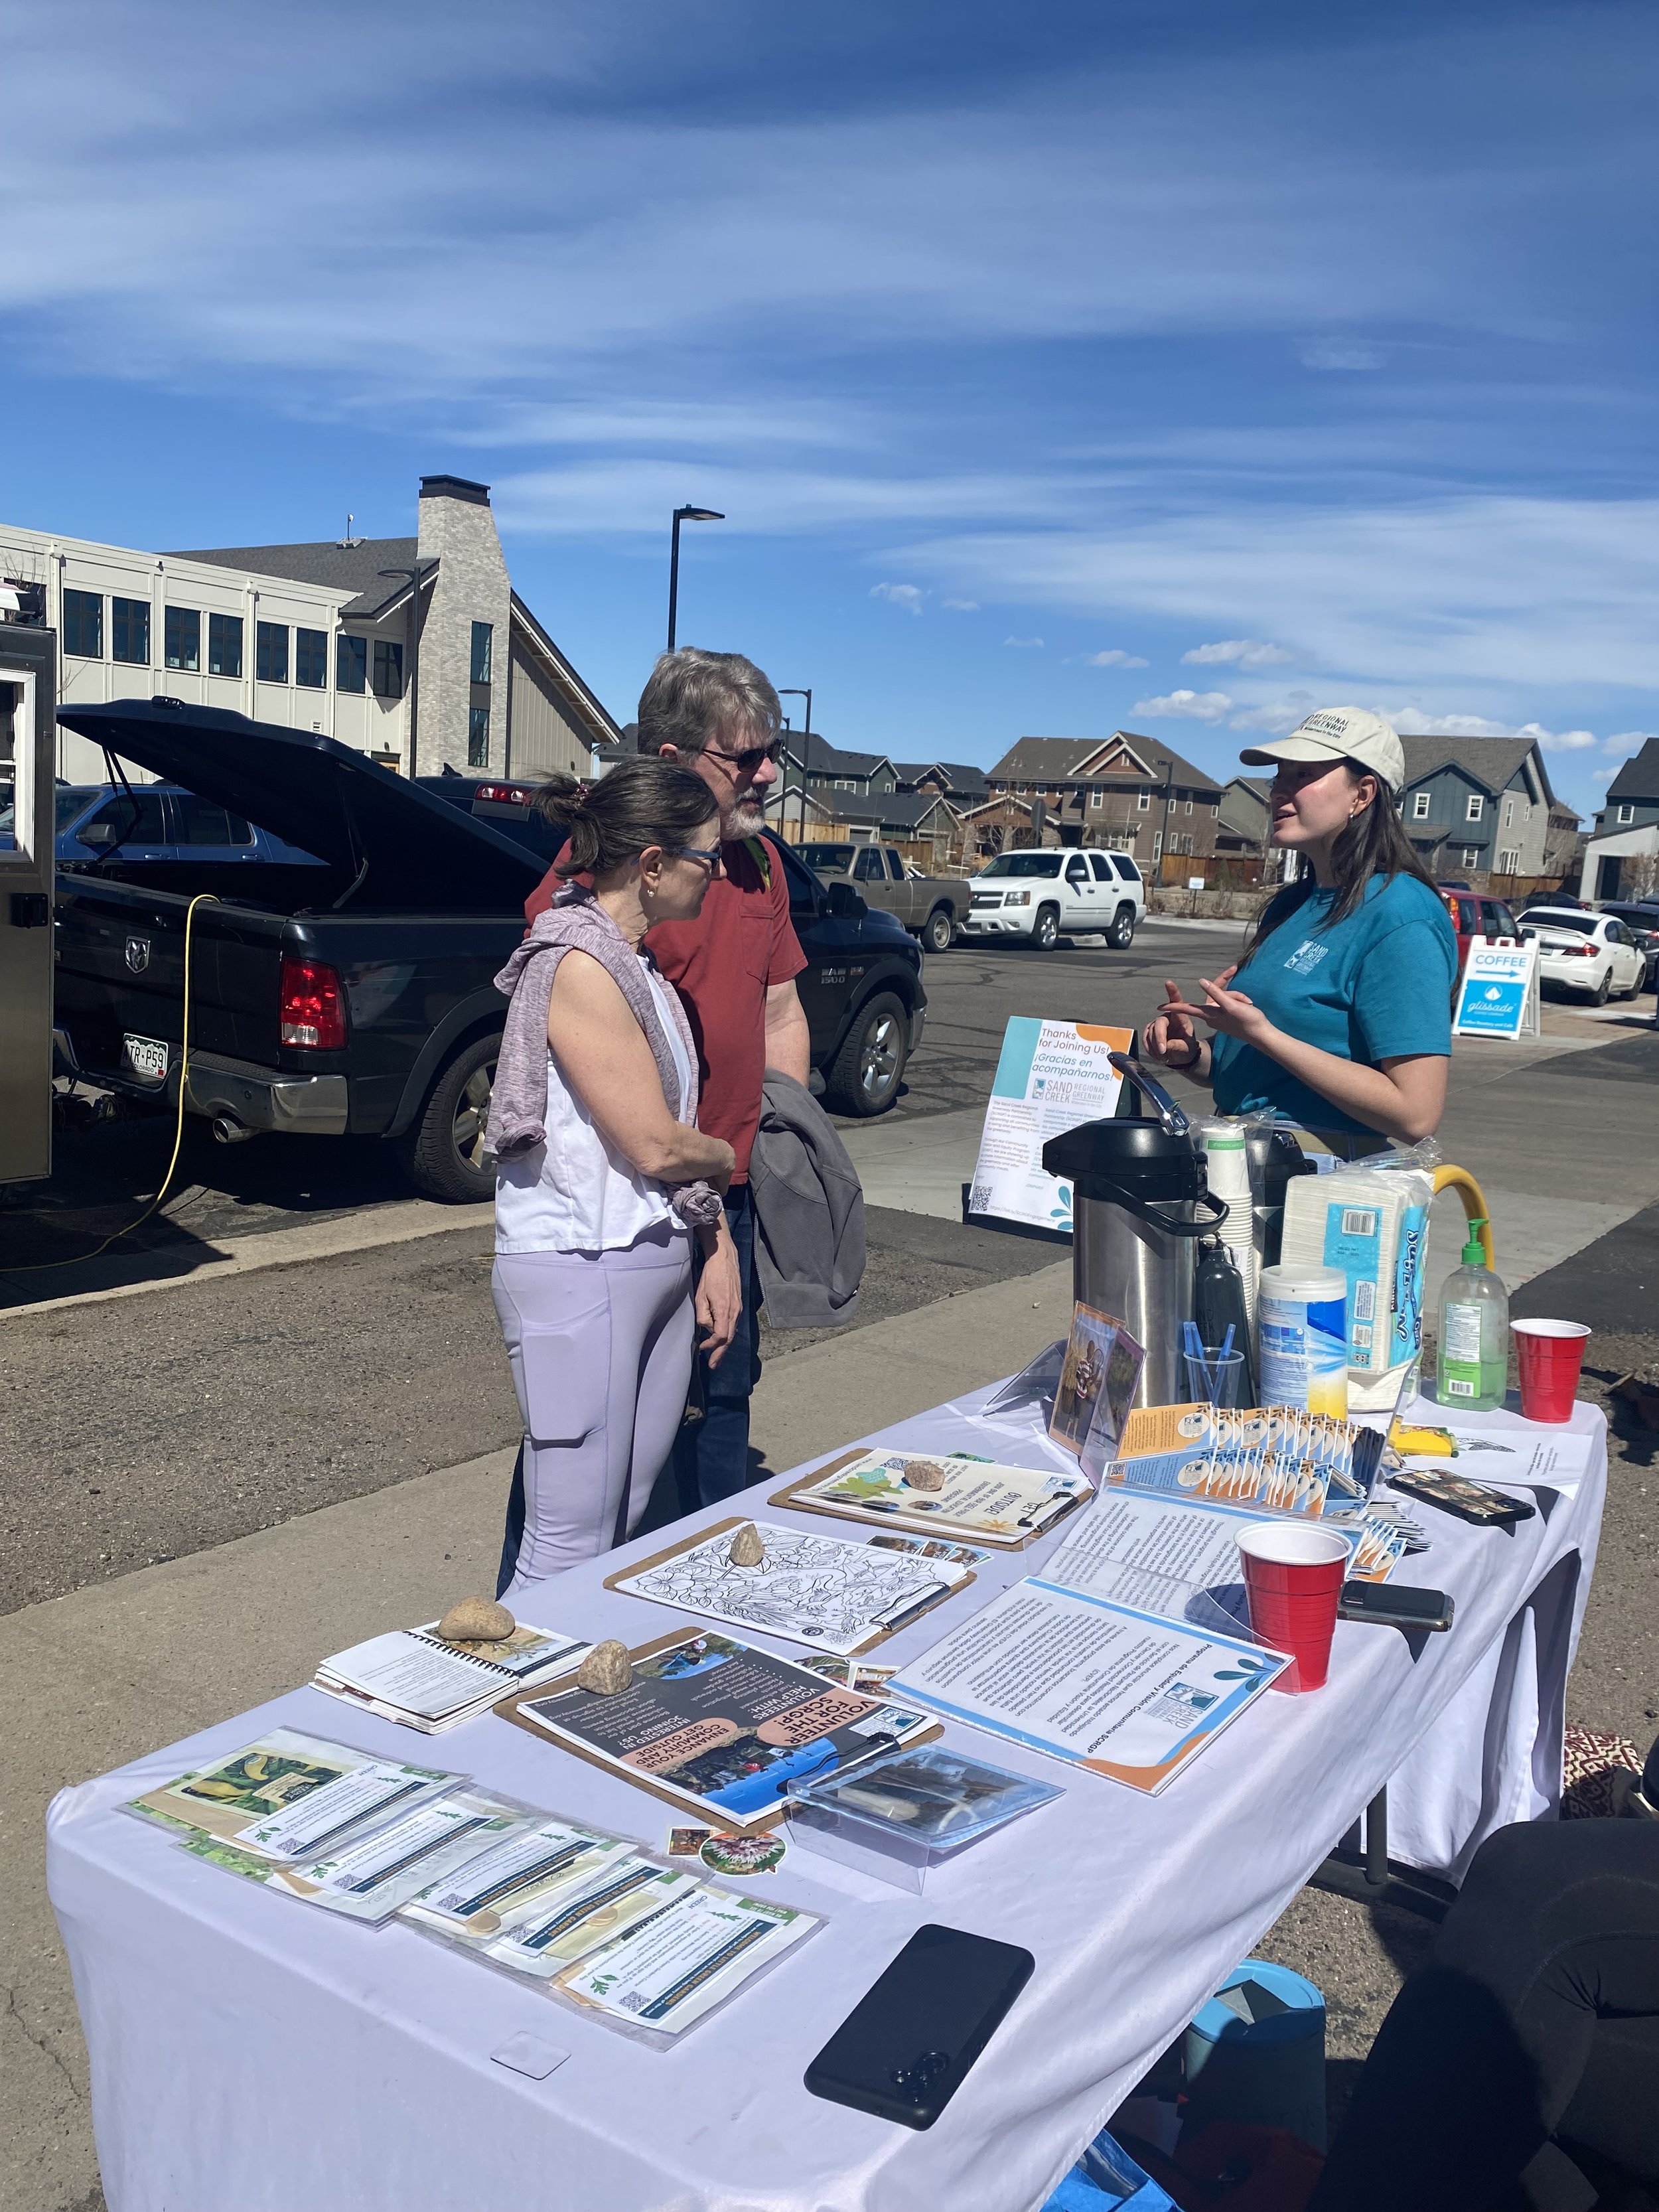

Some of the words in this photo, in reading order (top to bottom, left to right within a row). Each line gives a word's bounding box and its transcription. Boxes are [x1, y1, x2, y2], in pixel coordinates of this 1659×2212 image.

[1314, 714, 1349, 726] REGIONAL
[1309, 943, 1329, 957] SAND
[1476, 954, 1528, 967] COFFEE
[1042, 1028, 1076, 1040] Thanks
[1039, 1039, 1052, 1048] for
[1054, 1041, 1092, 1055] Joining
[1094, 1045, 1110, 1055] Us!
[1035, 1053, 1076, 1066] ¡Gracias
[1079, 1059, 1092, 1068] en
[1032, 1065, 1114, 1081] acompañarnos!
[1046, 1080, 1072, 1093] SAND
[1074, 1084, 1106, 1094] REGIONAL
[1045, 1092, 1070, 1103] CREEK
[1072, 1091, 1104, 1101] GREENWAY
[981, 1492, 1023, 1515] OUTSIDE!
[1018, 1502, 1041, 1513] GET
[1184, 1643, 1212, 1664] Programa
[706, 1664, 747, 1681] maintenance
[709, 1666, 729, 1675] more!
[722, 1666, 755, 1680] Pollinator
[727, 1670, 760, 1684] Education
[747, 1672, 766, 1681] Trash
[699, 1679, 726, 1690] garden
[724, 1680, 751, 1692] removal
[747, 1675, 772, 1686] Invasive
[755, 1678, 780, 1689] Native
[1157, 1670, 1182, 1688] Equidad
[730, 1686, 749, 1694] weed
[731, 1687, 760, 1700] planting
[758, 1680, 786, 1693] projects
[776, 1686, 808, 1700] HELP
[603, 1691, 642, 1708] coordinator
[689, 1688, 719, 1701] outreach
[700, 1694, 732, 1708] mitigation
[739, 1690, 778, 1708] enhancement
[1137, 1691, 1158, 1706] Visión
[618, 1698, 639, 1706] Email
[635, 1698, 658, 1708] about
[747, 1698, 781, 1714] WITH:
[749, 1687, 820, 1720] VOLUNTEERS
[569, 1708, 595, 1719] sign-up
[579, 1710, 609, 1722] volunteer
[603, 1706, 638, 1722] upcoming
[629, 1705, 657, 1717] receive
[634, 1706, 666, 1720] volunteer
[772, 1696, 833, 1726] SCRGP!
[814, 1701, 849, 1718] FOR
[1161, 1703, 1190, 1725] CREEK
[593, 1715, 632, 1732] information
[641, 1711, 670, 1724] Become
[783, 1716, 818, 1733] THE
[784, 1699, 876, 1745] VOLUNTEER
[1105, 1705, 1141, 1735] Comunitaria
[1171, 1707, 1204, 1730] SAND
[581, 1720, 605, 1730] events.
[614, 1720, 636, 1730] email
[631, 1718, 692, 1745] INTERESTED
[638, 1716, 683, 1735] JOINING
[681, 1724, 705, 1735] GET
[614, 1735, 638, 1745] US?
[635, 1734, 684, 1757] OUTSIDE
[674, 1728, 730, 1754] ENHANCE
[1084, 1733, 1109, 1753] SCRGP
[634, 1751, 662, 1765] AND
[644, 1753, 676, 1769] YOUR
[617, 1875, 648, 1891] WELCOME
[591, 1894, 614, 1905] LITTLE
[572, 1903, 597, 1917] GREEN
[545, 1915, 578, 1937] GARDENS
[733, 1930, 761, 1951] WELCOME
[707, 1955, 729, 1971] LITTLE
[690, 1969, 713, 1985] GREEN
[664, 1984, 695, 2006] GARDENS
